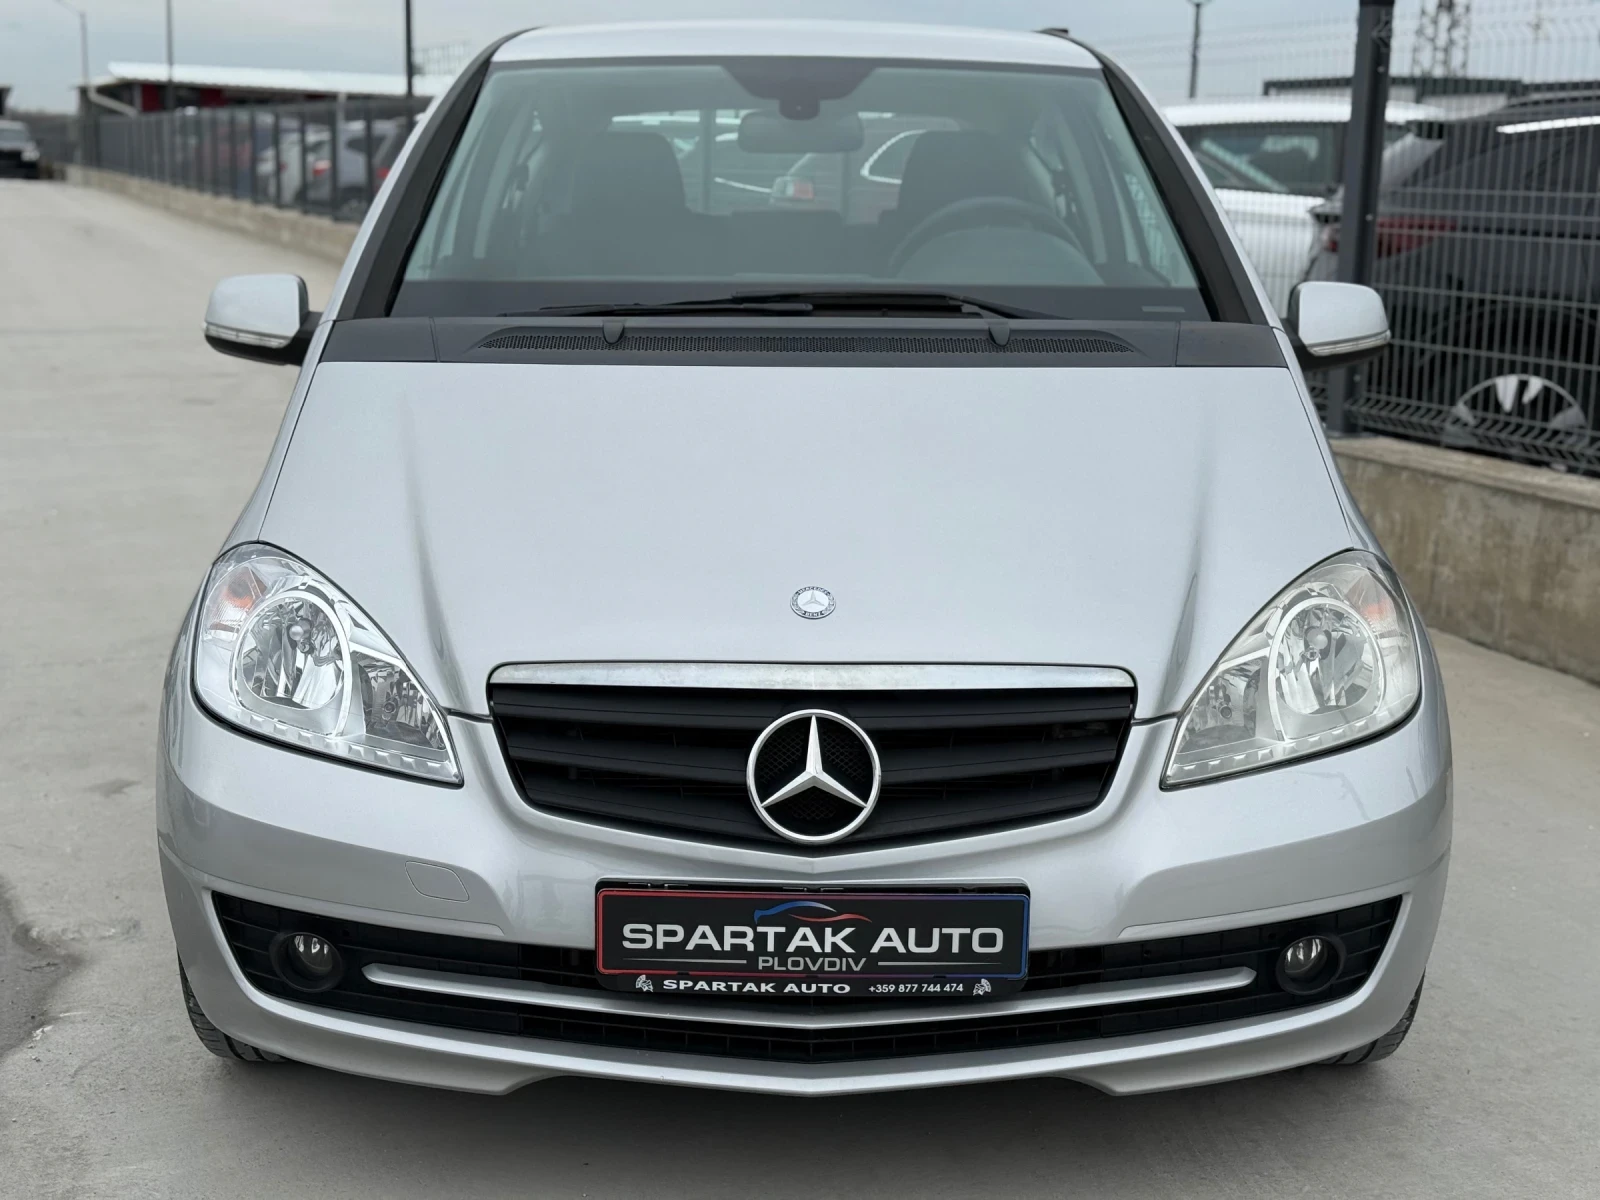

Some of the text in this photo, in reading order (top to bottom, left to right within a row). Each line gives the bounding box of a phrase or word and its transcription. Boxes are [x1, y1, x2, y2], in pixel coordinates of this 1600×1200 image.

[622, 923, 1004, 954] SPARTAK AUTO
[758, 956, 867, 972] PLOVDIV
[663, 979, 851, 994] SPARTAK AUTO
[868, 983, 964, 993] +359 877 744 474
